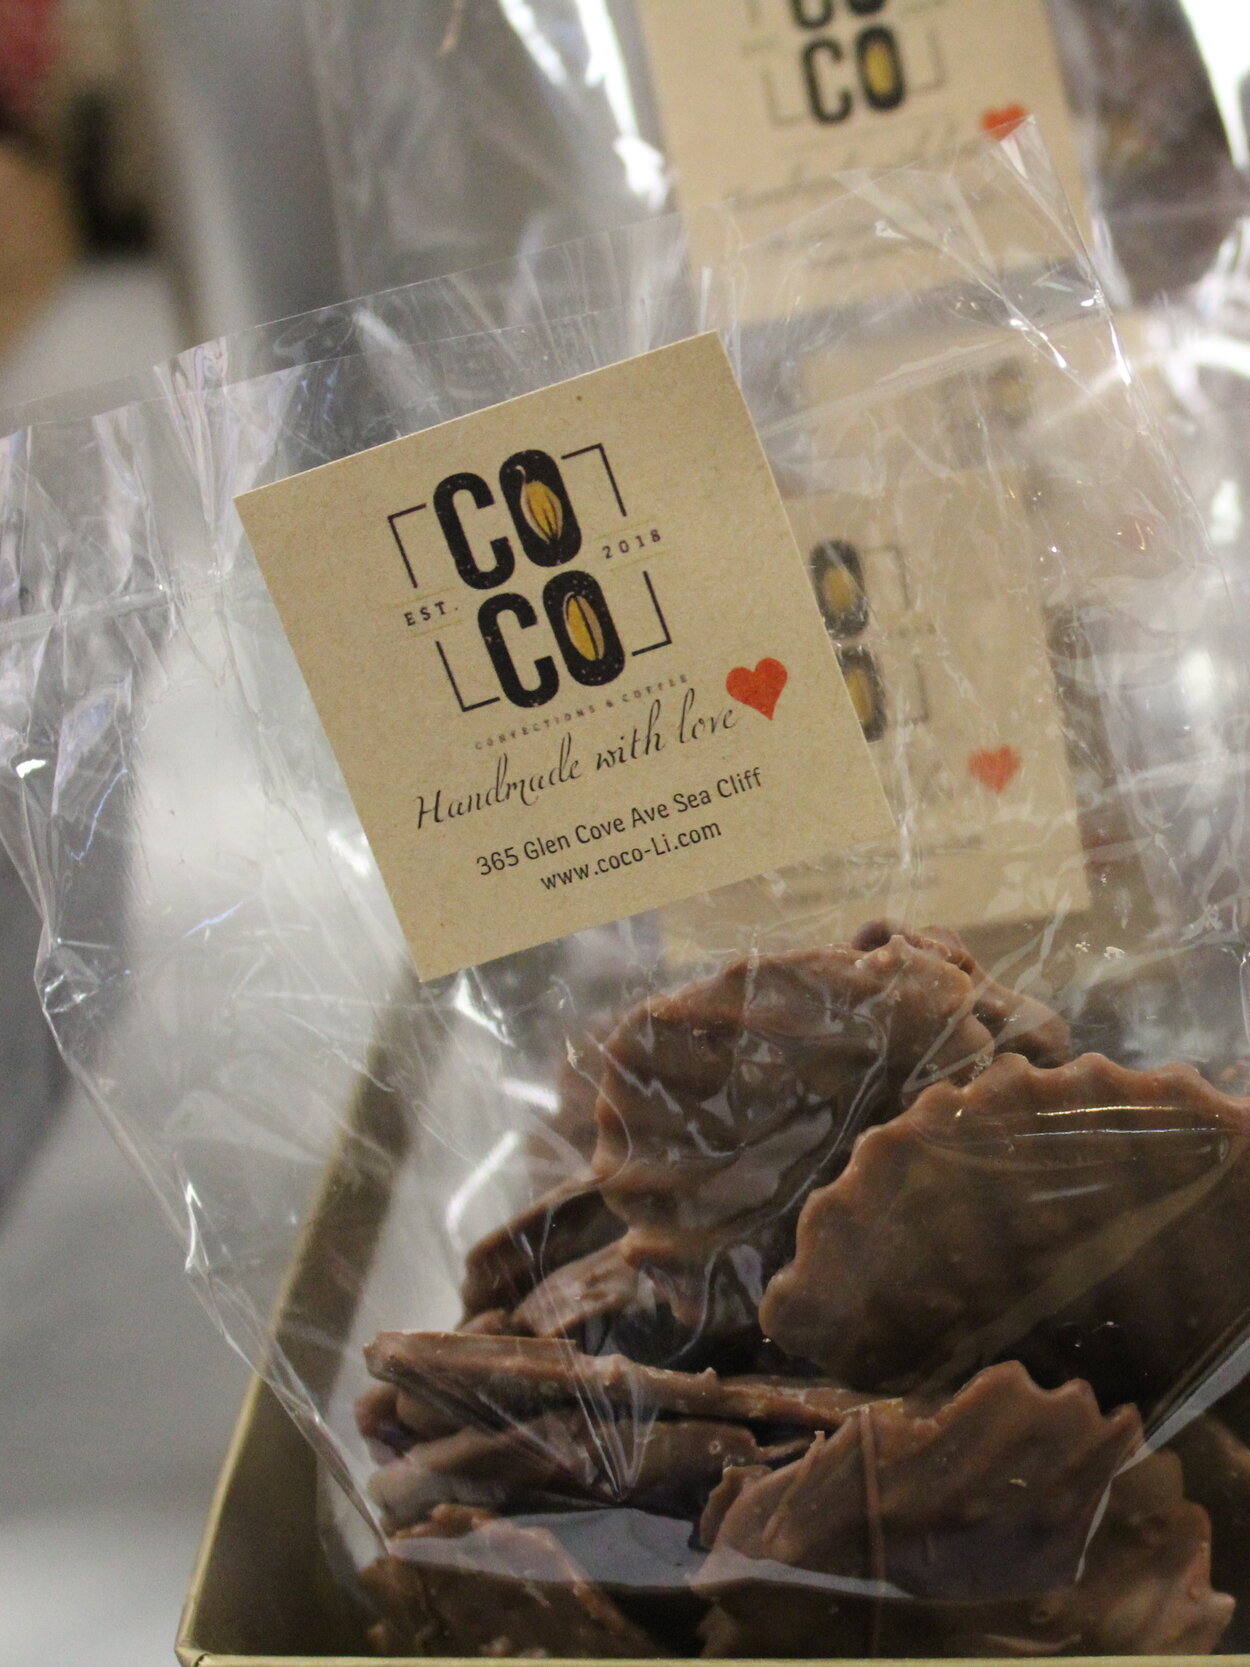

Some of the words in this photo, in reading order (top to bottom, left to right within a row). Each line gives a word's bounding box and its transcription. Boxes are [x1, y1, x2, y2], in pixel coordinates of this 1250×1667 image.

[433, 449, 582, 590] CO
[602, 528, 662, 560] 2018
[403, 600, 460, 628] EST.
[477, 570, 625, 709] CO
[416, 732, 583, 830] Handmade
[596, 699, 666, 772] with
[679, 688, 738, 744] love
[476, 846, 520, 876] 365
[523, 831, 571, 861] Glen
[574, 814, 625, 845] Cove
[631, 799, 671, 828] Ave
[672, 787, 713, 814] Sea
[716, 767, 763, 798] Cliff
[540, 820, 723, 890] www.coco-Li.com
